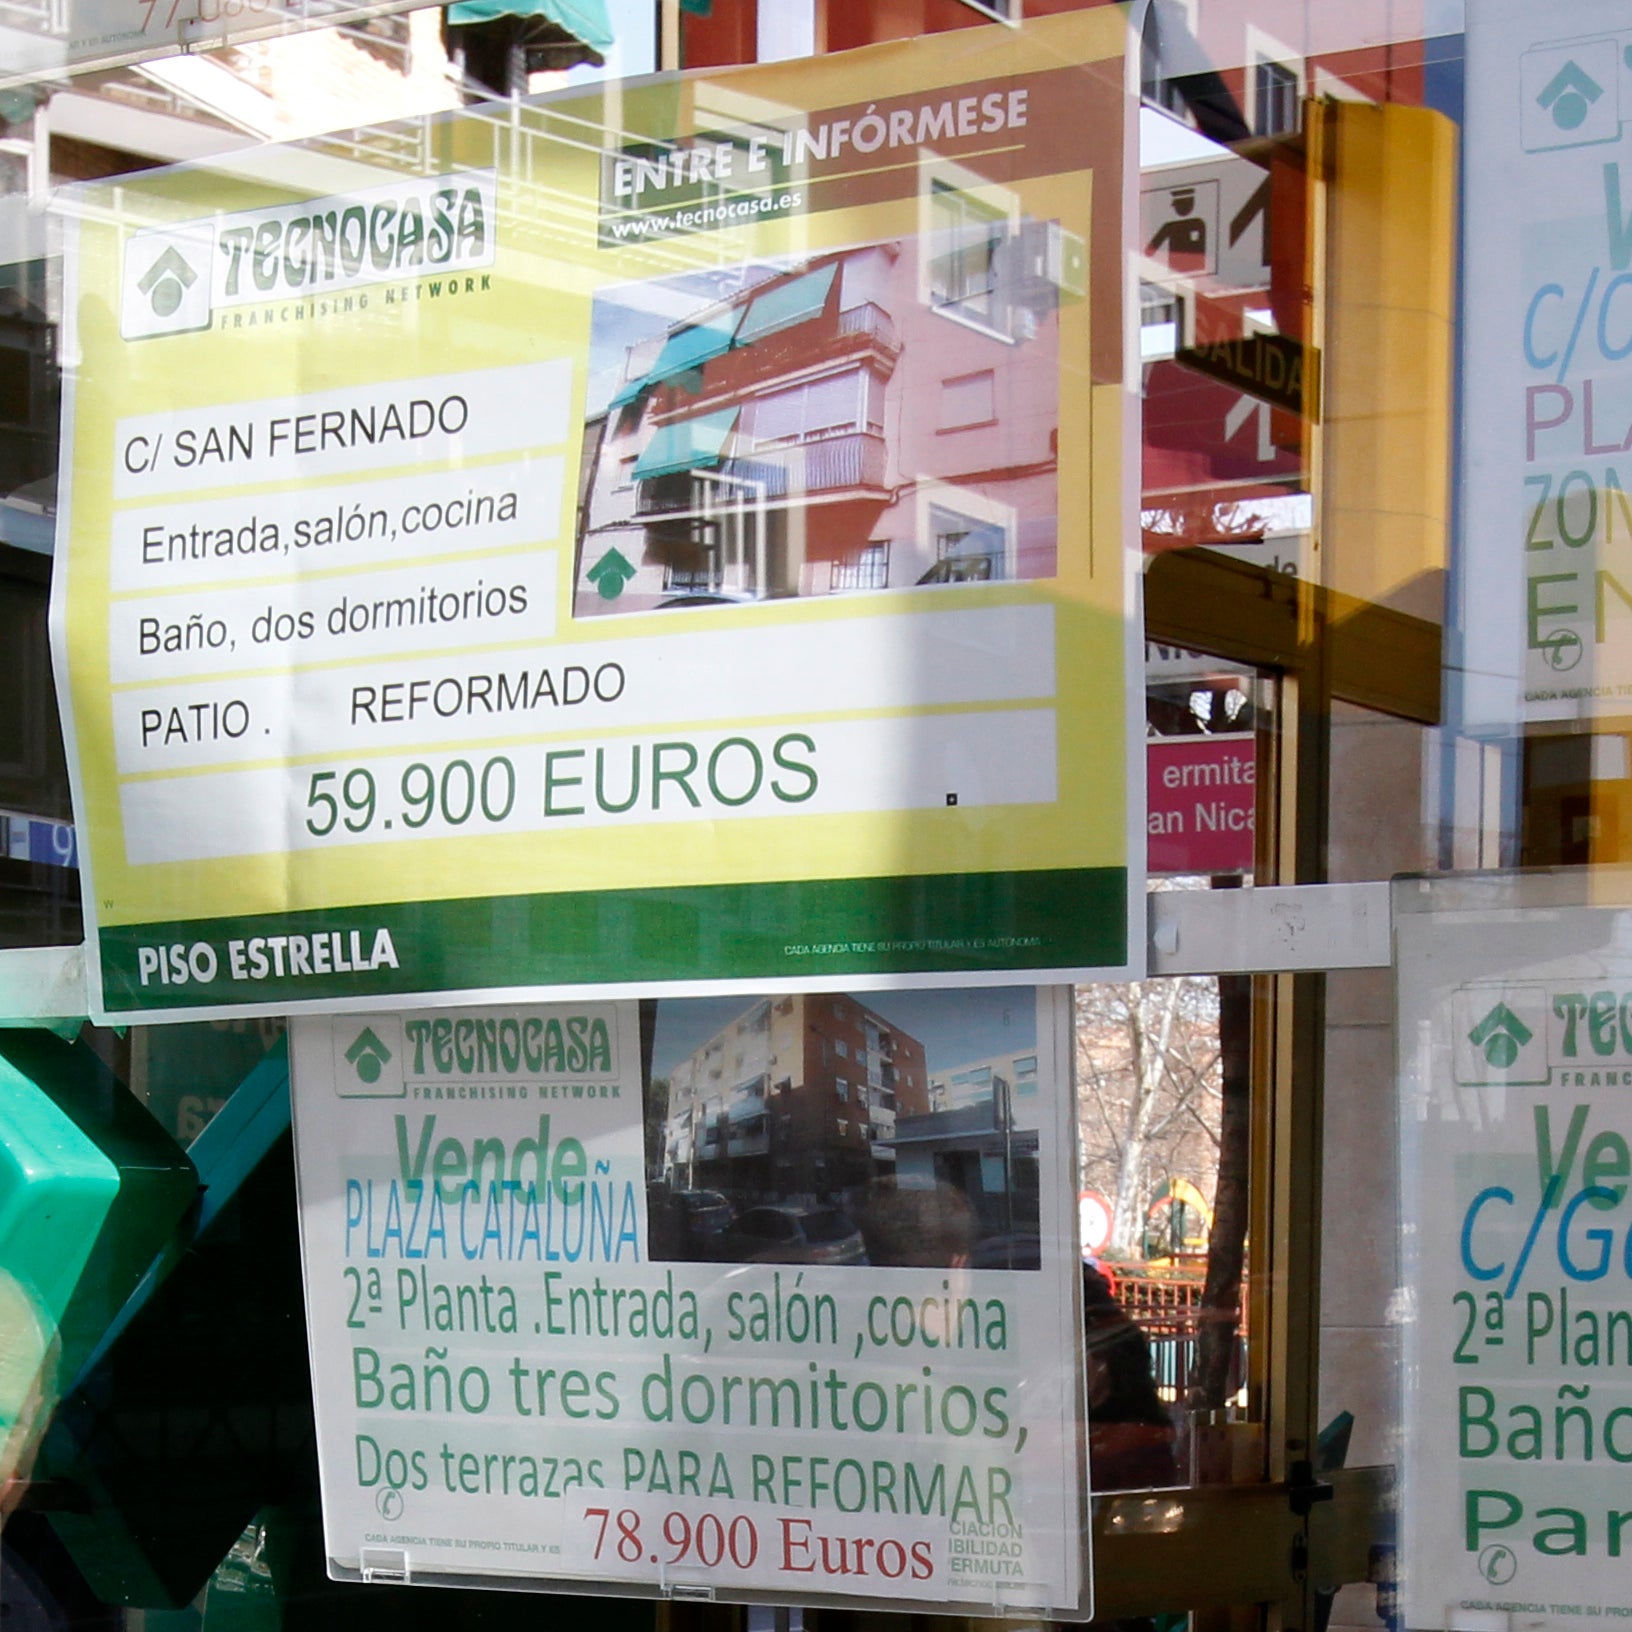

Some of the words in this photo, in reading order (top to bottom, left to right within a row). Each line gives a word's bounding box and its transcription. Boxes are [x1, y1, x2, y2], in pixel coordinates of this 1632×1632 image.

[615, 146, 733, 197] ENTRE
[748, 135, 766, 173] E
[783, 90, 1030, 165] INFÓRMESE
[217, 182, 488, 296] TECNOCASA
[610, 190, 804, 241] www.tecnocasa.es
[124, 433, 162, 476] C/
[175, 418, 253, 467] SAN
[269, 396, 468, 456] FERNADO
[138, 614, 236, 655] Baño,
[252, 604, 314, 644] dos
[327, 578, 528, 633] dormitorios
[139, 699, 250, 747] PATIO
[350, 662, 626, 725] REFORMADO
[305, 755, 516, 838] 59.900
[543, 734, 818, 817] EUROS
[137, 937, 217, 986] PISO
[228, 926, 400, 979] ESTRELLA
[406, 1017, 611, 1076] TECNOCASA
[414, 1087, 528, 1100] FRANCHISING
[540, 1086, 621, 1099] NETWORK
[346, 1178, 446, 1262] PLAZA
[460, 1161, 639, 1264] CATALUÑA
[346, 1268, 382, 1328] 2ª
[398, 1266, 517, 1335] Planta
[729, 1272, 837, 1345] salón
[1452, 1292, 1505, 1364] 2ª
[353, 1346, 490, 1413] Baño
[511, 1358, 619, 1420] tres
[642, 1353, 1028, 1454] dormitorios,
[357, 1437, 427, 1492] Dos
[753, 1455, 1014, 1525] REFORMAR
[583, 1507, 759, 1569] 78.900
[779, 1516, 934, 1580] Euros
[1550, 1604, 1582, 1615] TIENE
[1587, 1606, 1600, 1615] SU
